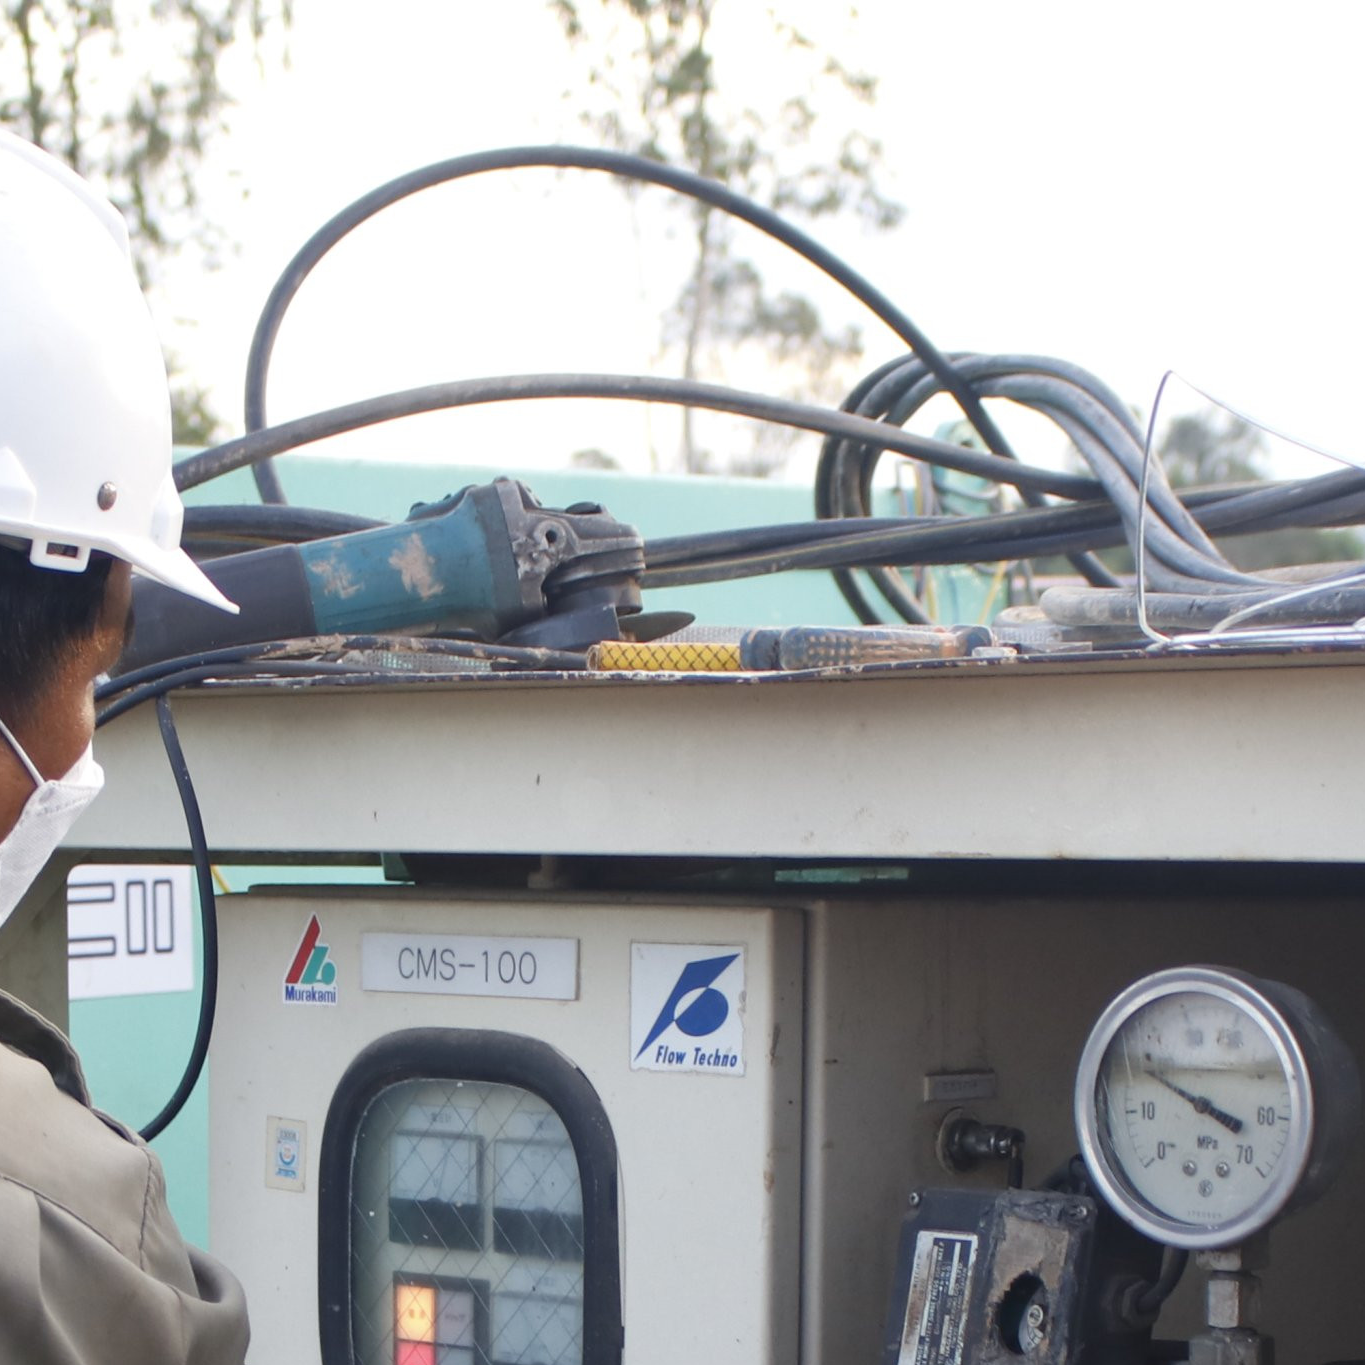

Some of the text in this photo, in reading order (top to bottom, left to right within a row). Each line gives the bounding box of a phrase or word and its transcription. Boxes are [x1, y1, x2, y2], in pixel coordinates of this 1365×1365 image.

[397, 946, 537, 985] CMS-100
[284, 985, 337, 1004] Murakami
[655, 1045, 738, 1068] Flow Techno
[1141, 1101, 1156, 1121] 10
[1256, 1106, 1275, 1127] 60
[1196, 1135, 1219, 1150] MPa
[1236, 1144, 1254, 1165] 70
